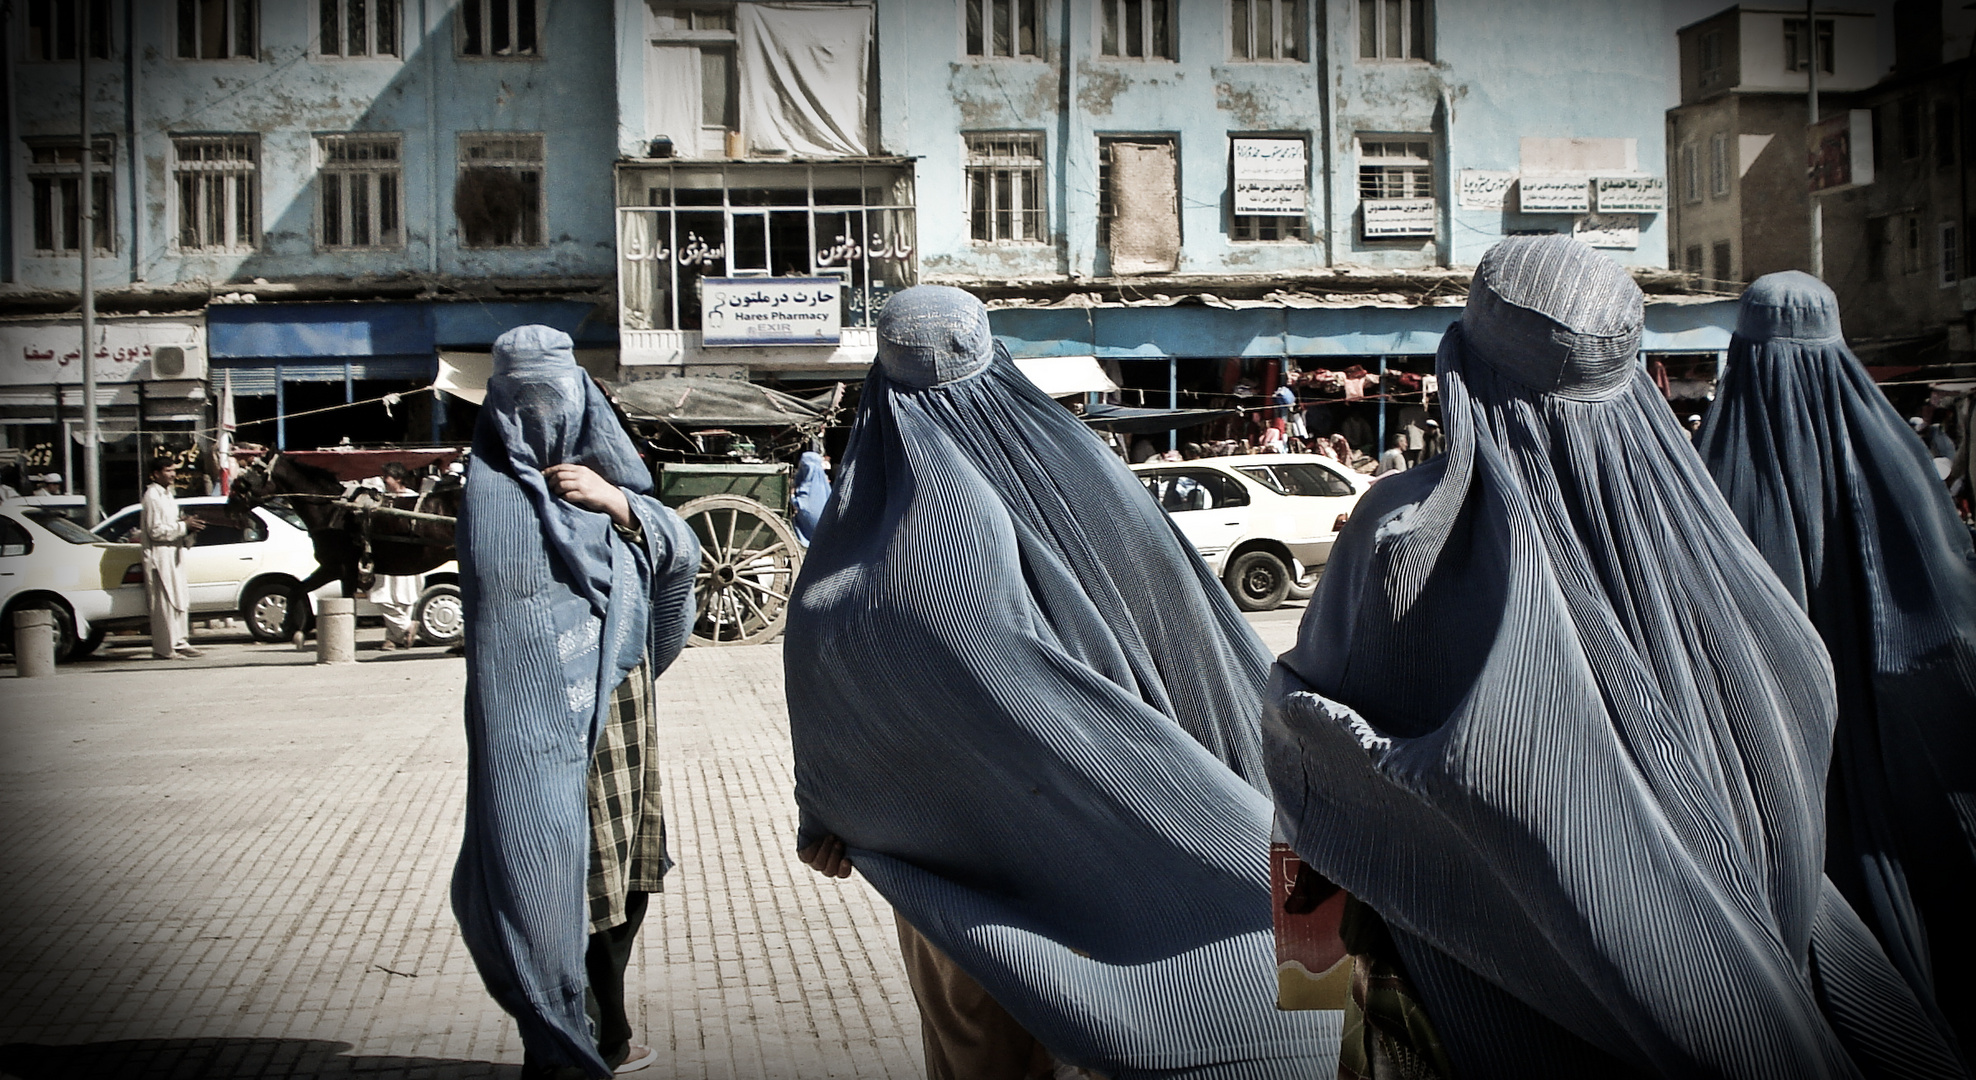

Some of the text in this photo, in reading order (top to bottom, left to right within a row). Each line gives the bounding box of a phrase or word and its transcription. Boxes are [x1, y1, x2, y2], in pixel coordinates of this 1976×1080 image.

[624, 238, 669, 260] حارث
[868, 232, 914, 260] حارث
[793, 290, 834, 307] حارث
[735, 312, 830, 322] Hares Pharmacy
[757, 323, 792, 332] EXIR
[23, 343, 55, 362] صفا
